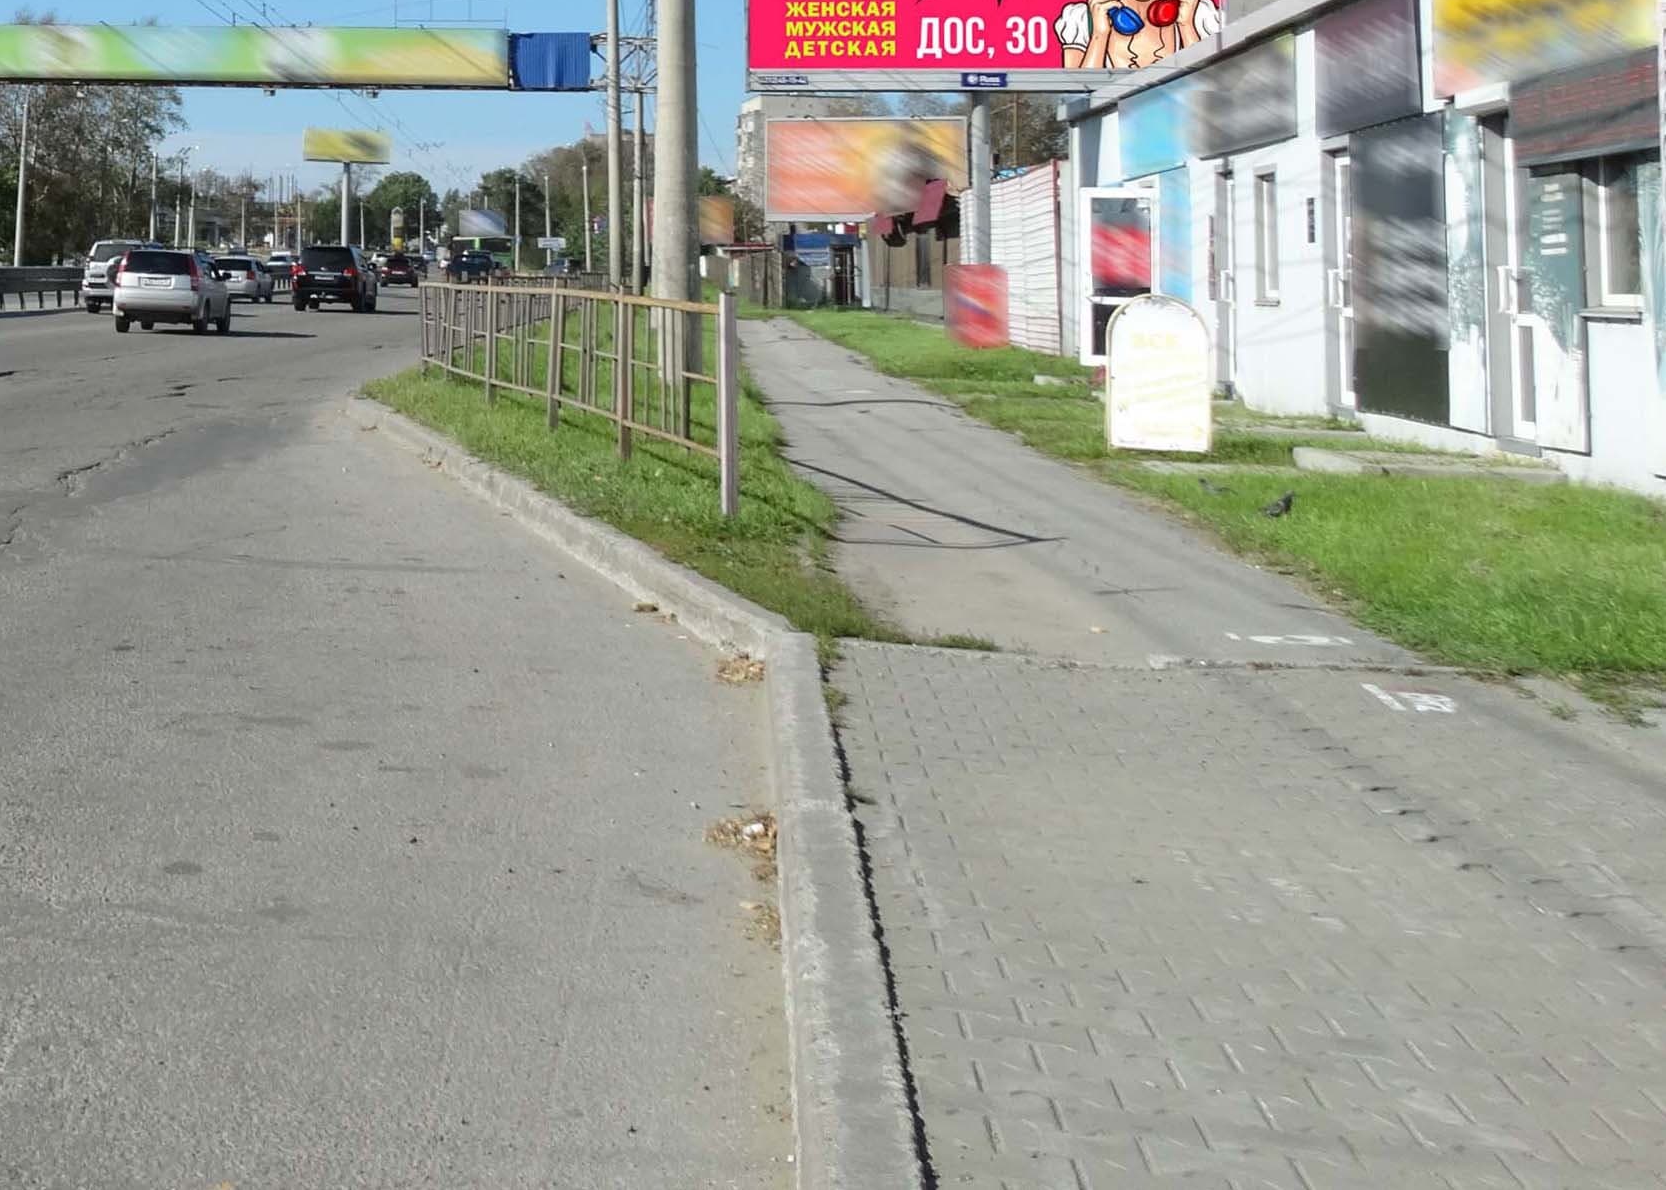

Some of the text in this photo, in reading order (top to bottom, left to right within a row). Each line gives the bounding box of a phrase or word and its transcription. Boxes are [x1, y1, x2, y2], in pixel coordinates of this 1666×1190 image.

[784, 0, 896, 18] ЖЕНСКАЯ
[785, 20, 896, 37] МУЖСКАЯ
[916, 15, 1048, 59] ДОС, 30
[784, 40, 896, 59] ДЕТСКАЯ
